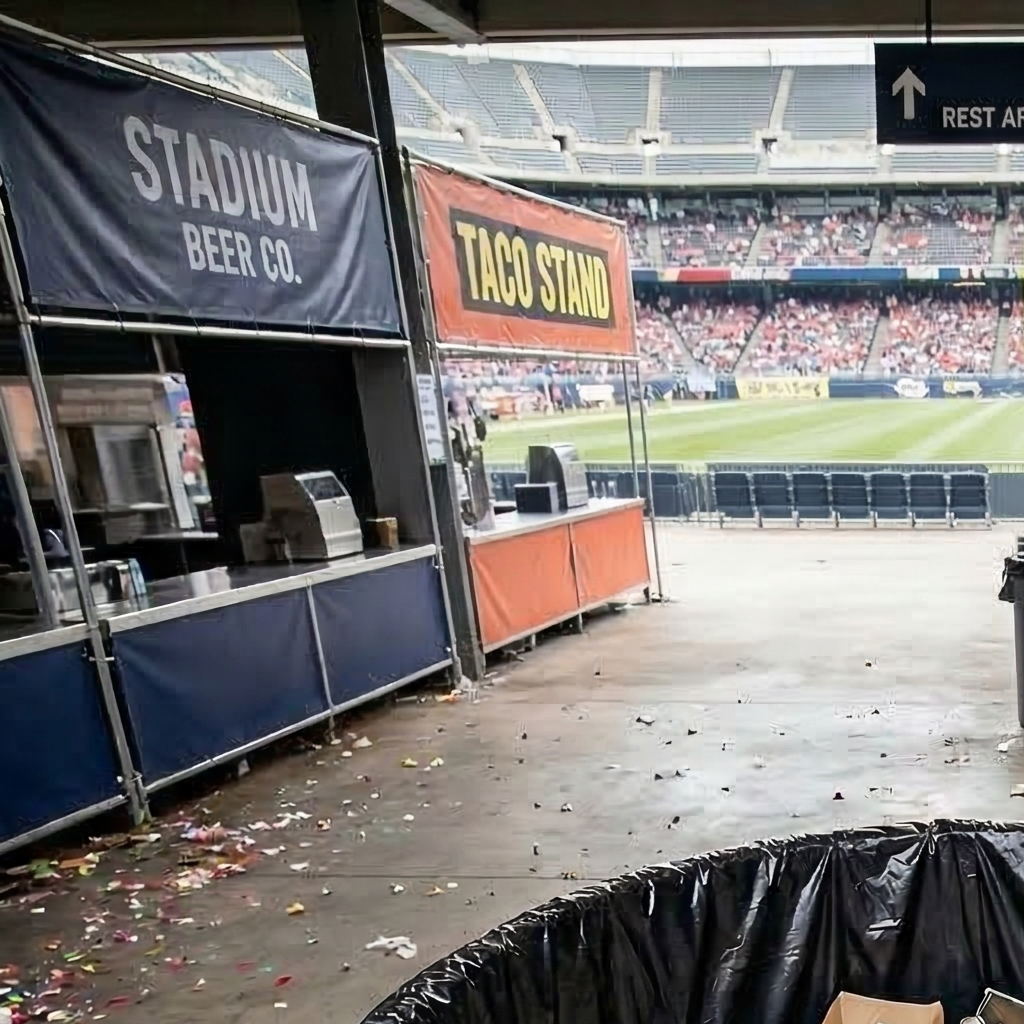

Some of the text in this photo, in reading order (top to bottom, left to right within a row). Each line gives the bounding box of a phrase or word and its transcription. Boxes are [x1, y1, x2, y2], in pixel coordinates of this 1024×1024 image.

[942, 106, 996, 128] REST
[123, 115, 318, 232] STADIUM
[181, 221, 303, 285] BEER CO.
[456, 220, 610, 320] TACO STAND
